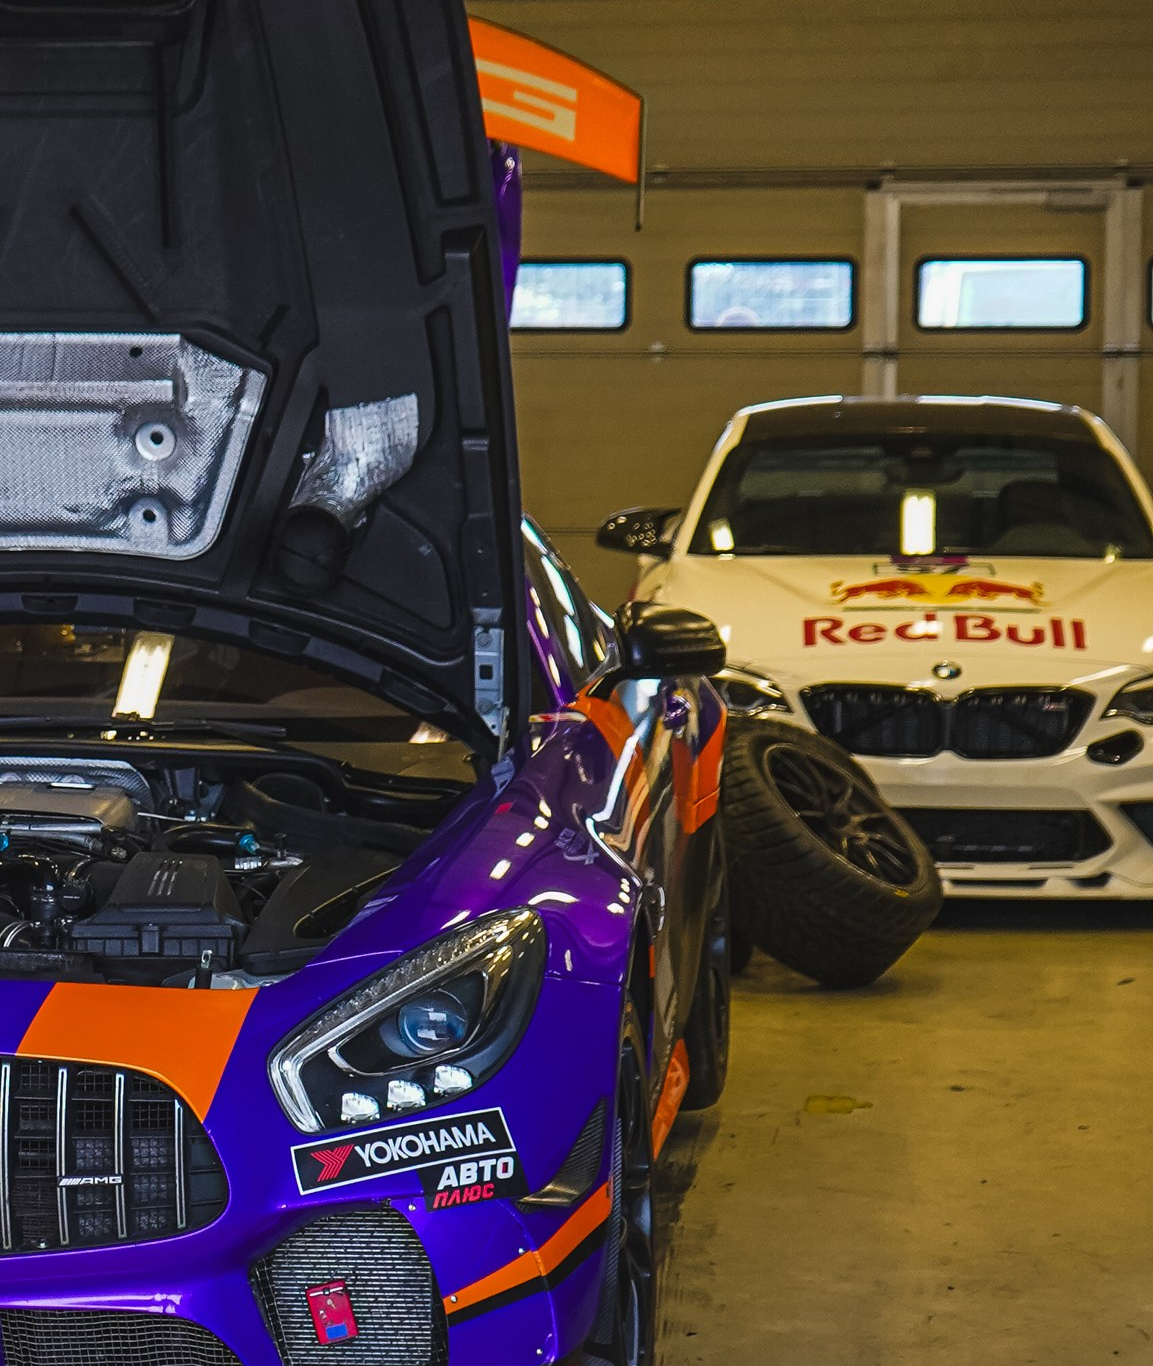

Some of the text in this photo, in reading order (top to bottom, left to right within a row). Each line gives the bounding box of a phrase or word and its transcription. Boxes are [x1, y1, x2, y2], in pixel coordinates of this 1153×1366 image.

[803, 612, 1086, 649] Red Bull
[354, 1122, 497, 1168] YOKOHAMA
[79, 1176, 122, 1185] AMG
[437, 1156, 515, 1190] АВТО
[433, 1183, 494, 1209] ПЛЮС
